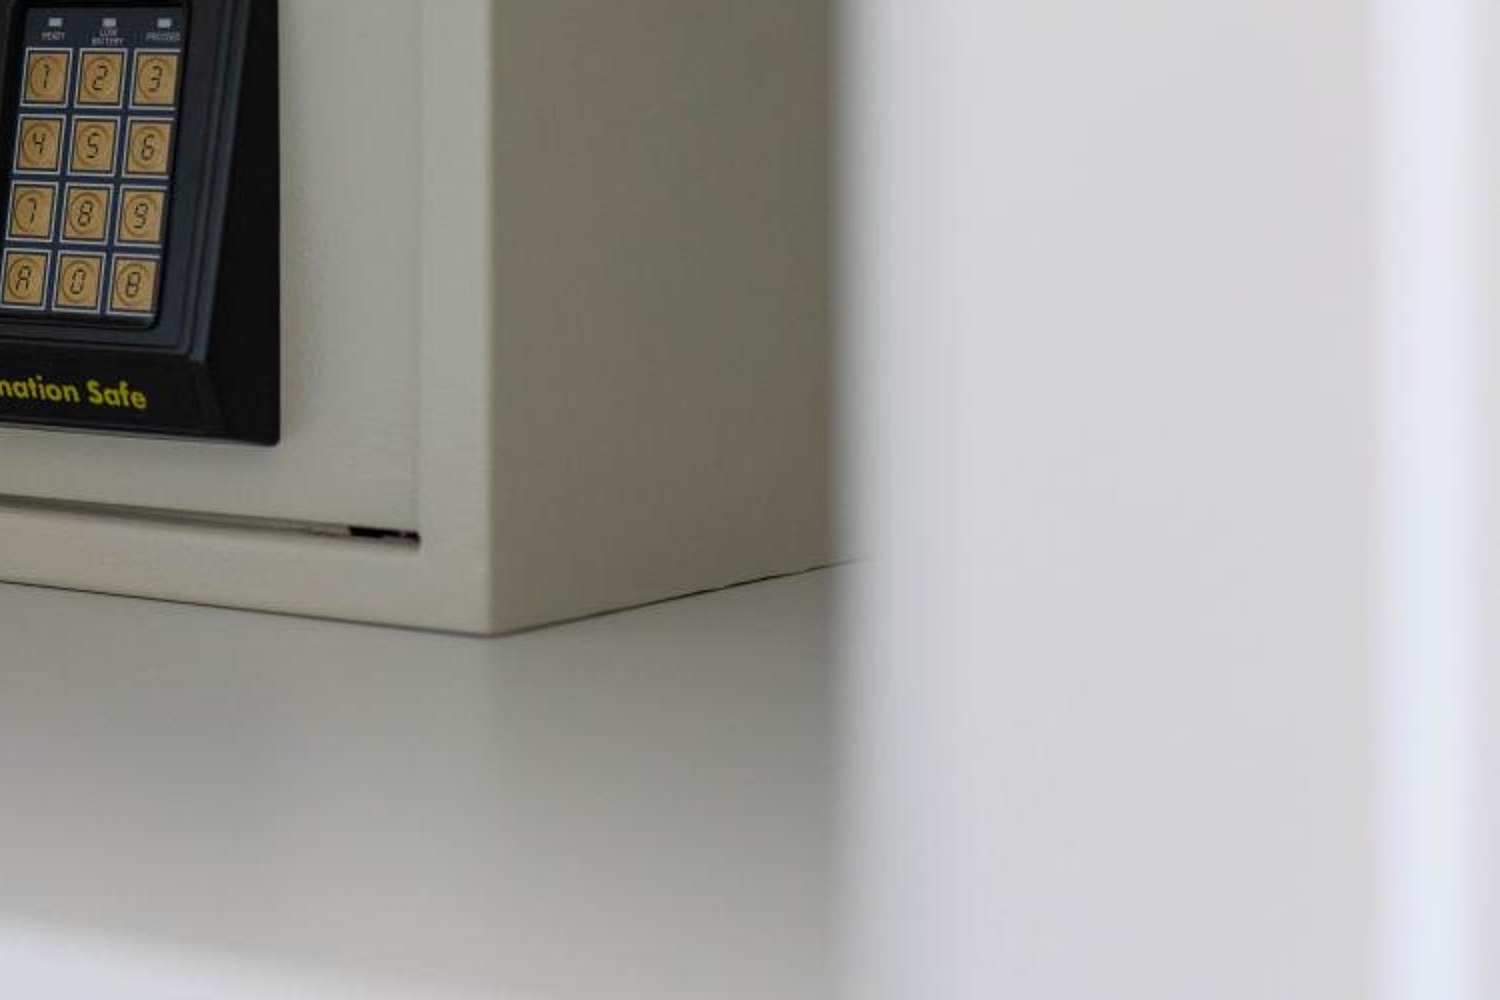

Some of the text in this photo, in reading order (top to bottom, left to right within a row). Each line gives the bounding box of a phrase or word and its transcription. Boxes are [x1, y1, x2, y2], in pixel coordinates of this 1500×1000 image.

[41, 64, 51, 89] 1
[92, 65, 108, 91] 2
[147, 65, 162, 92] 3
[32, 132, 46, 155] 4
[87, 133, 101, 159] 5
[142, 135, 155, 161] 6
[27, 198, 37, 225] 7
[77, 200, 93, 227] 8
[133, 202, 148, 229] 9
[15, 265, 31, 291] A
[70, 268, 86, 295] 0
[86, 380, 148, 410] Safe
